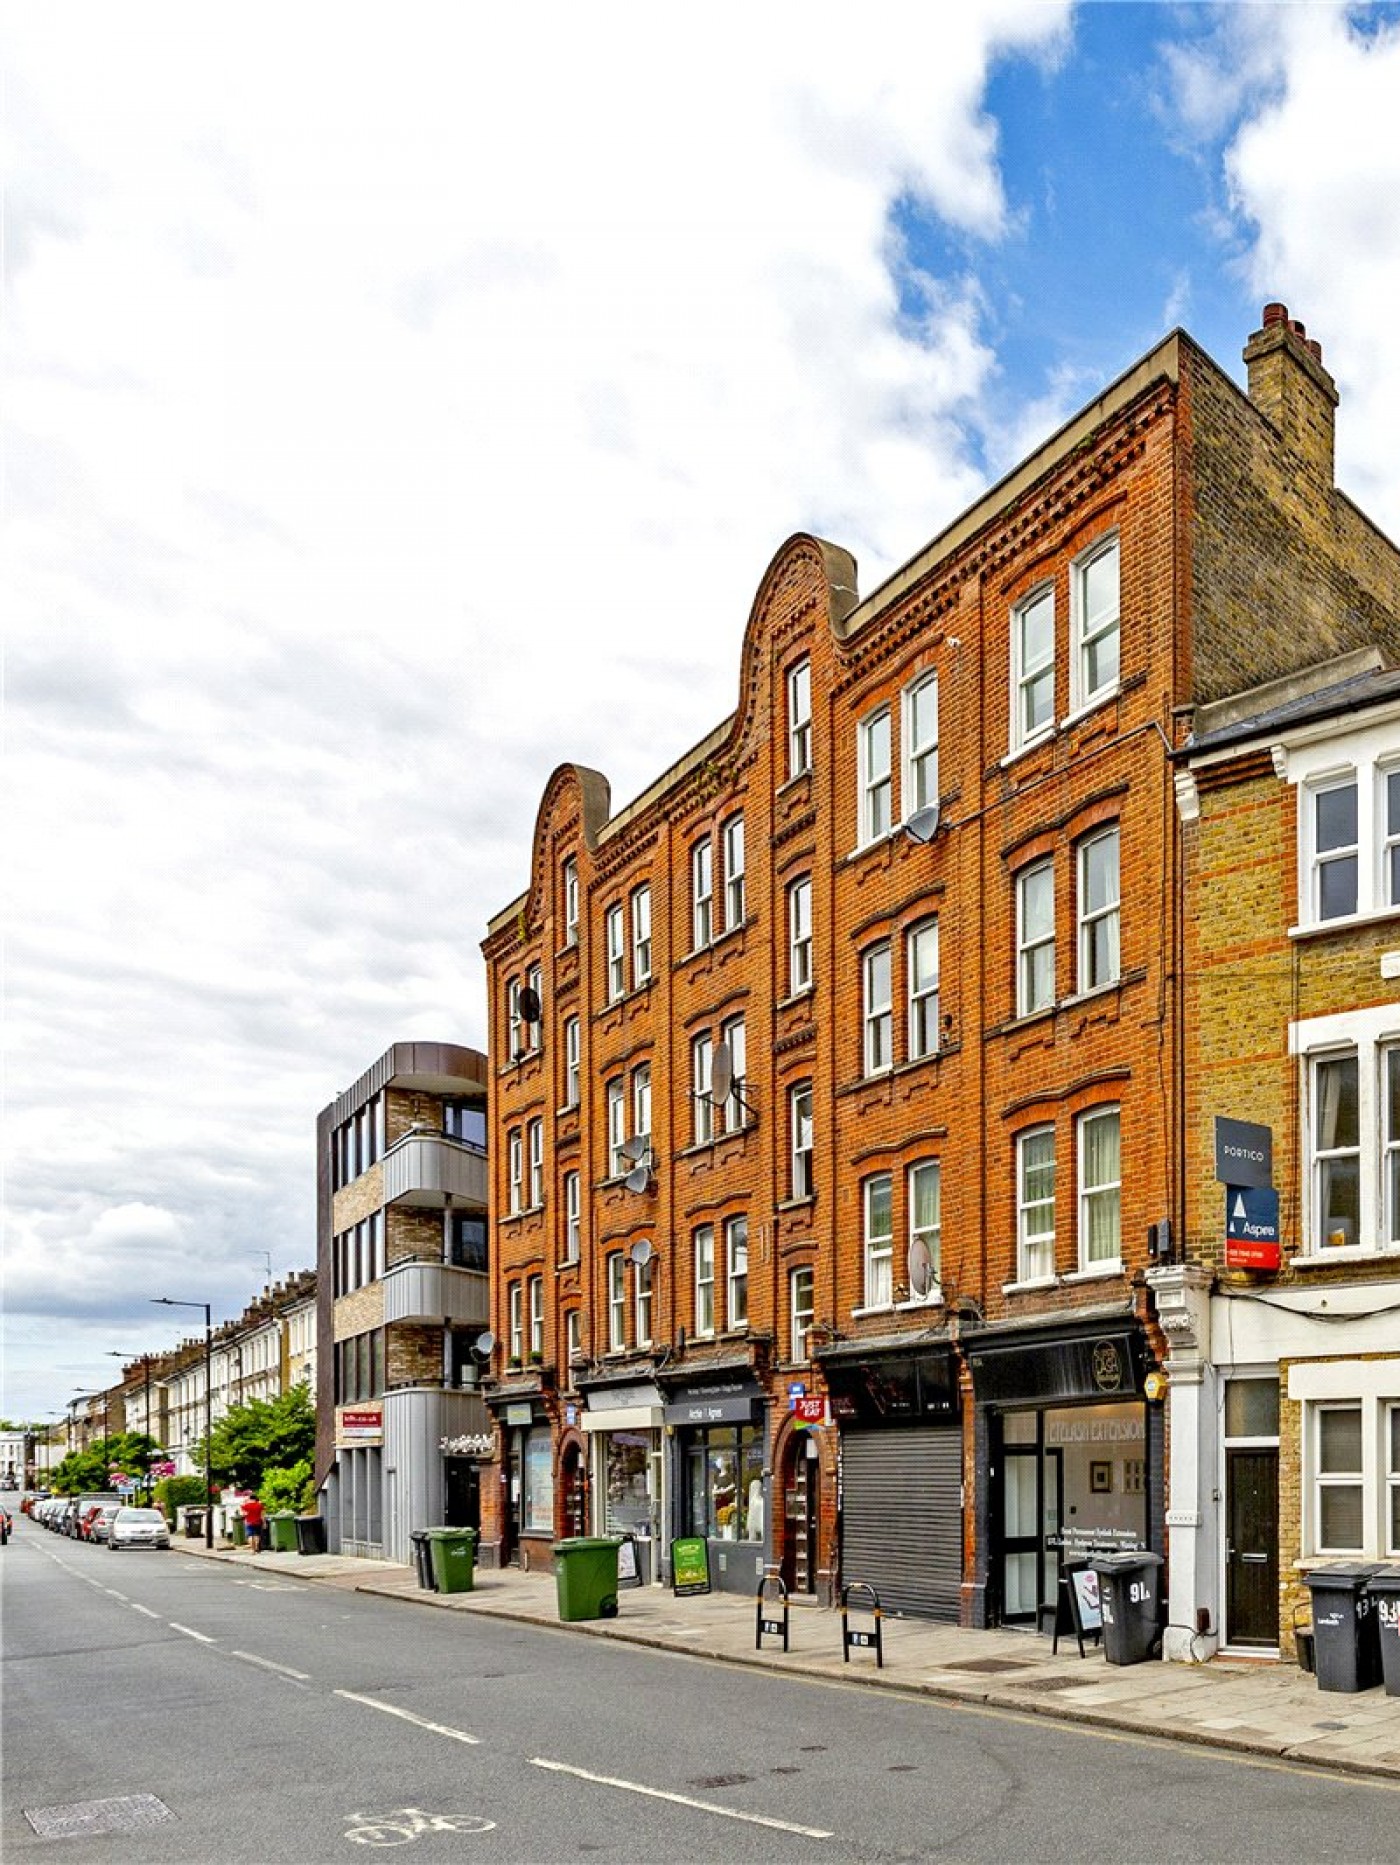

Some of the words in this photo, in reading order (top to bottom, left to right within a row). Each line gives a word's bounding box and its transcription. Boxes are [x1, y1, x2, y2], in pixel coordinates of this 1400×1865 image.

[1224, 1145, 1264, 1162] PORTICO
[800, 1400, 821, 1410] JUST
[804, 1408, 821, 1417] EAT
